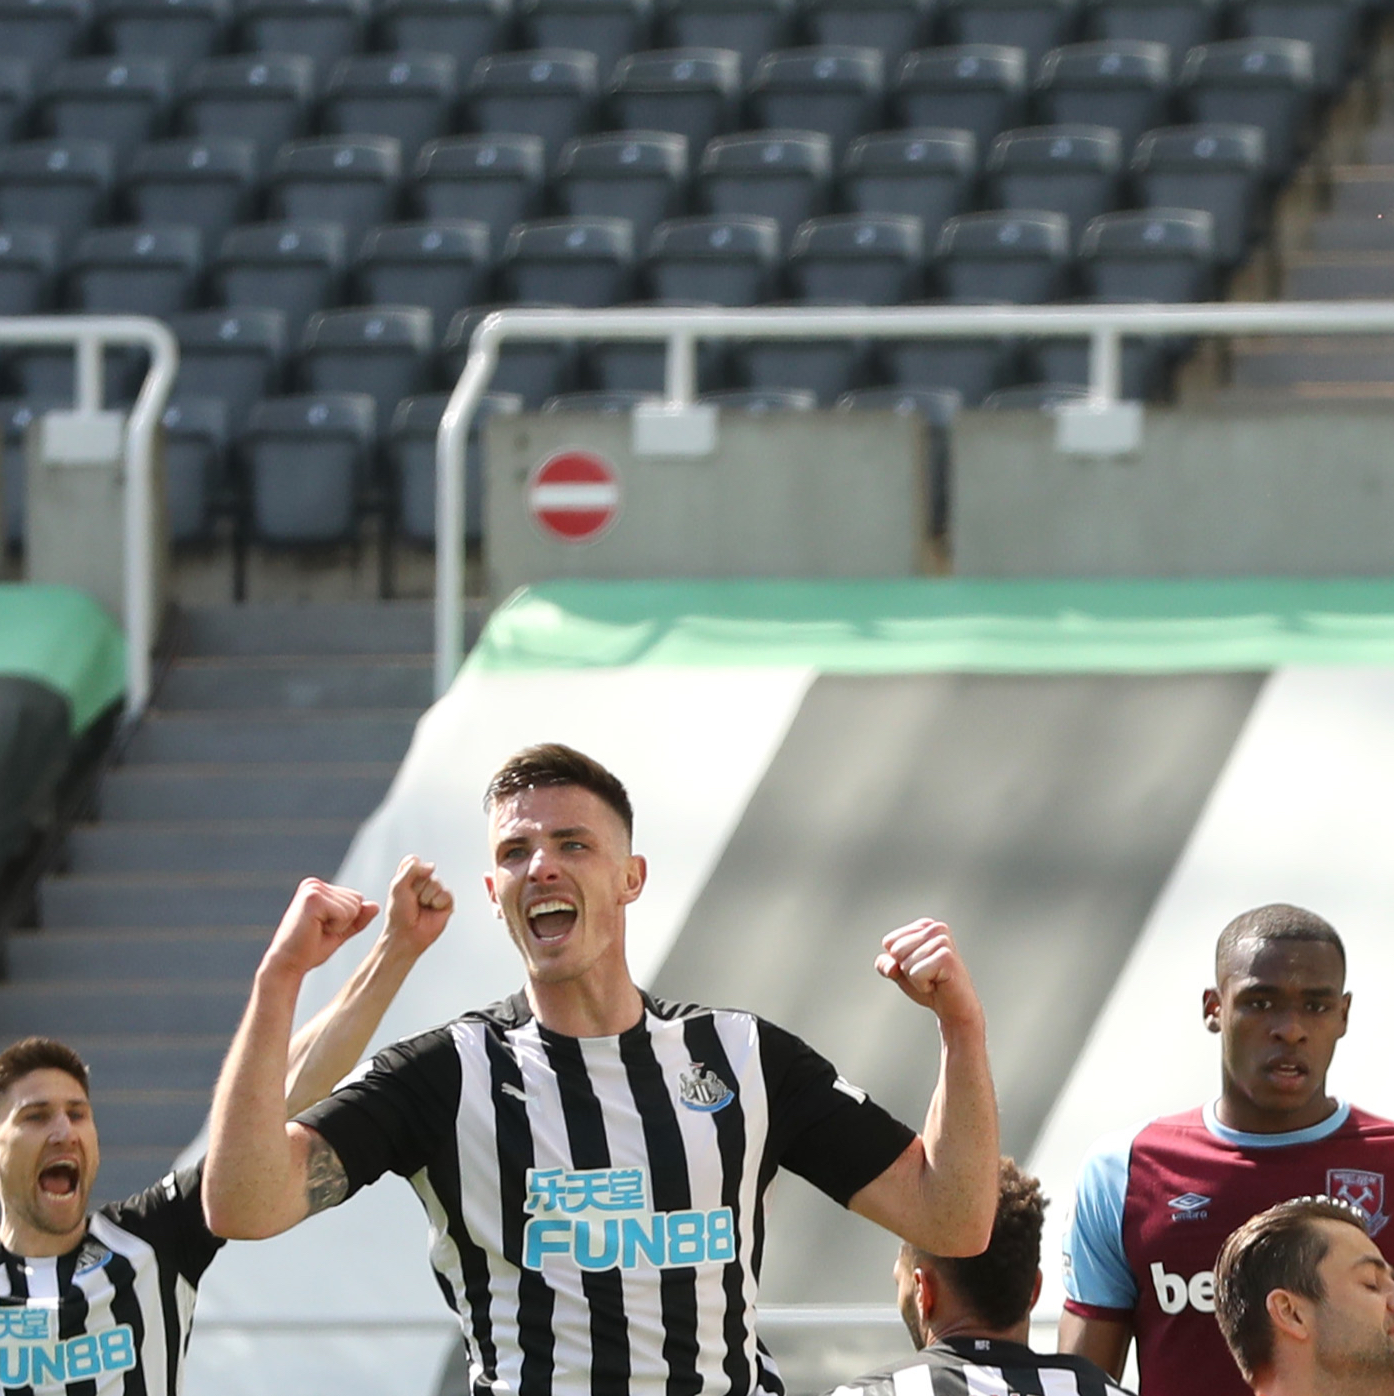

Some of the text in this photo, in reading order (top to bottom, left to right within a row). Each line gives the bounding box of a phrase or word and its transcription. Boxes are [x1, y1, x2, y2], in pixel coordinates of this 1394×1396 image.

[528, 1168, 646, 1214] 乐天堂
[525, 1209, 734, 1271] FUN88
